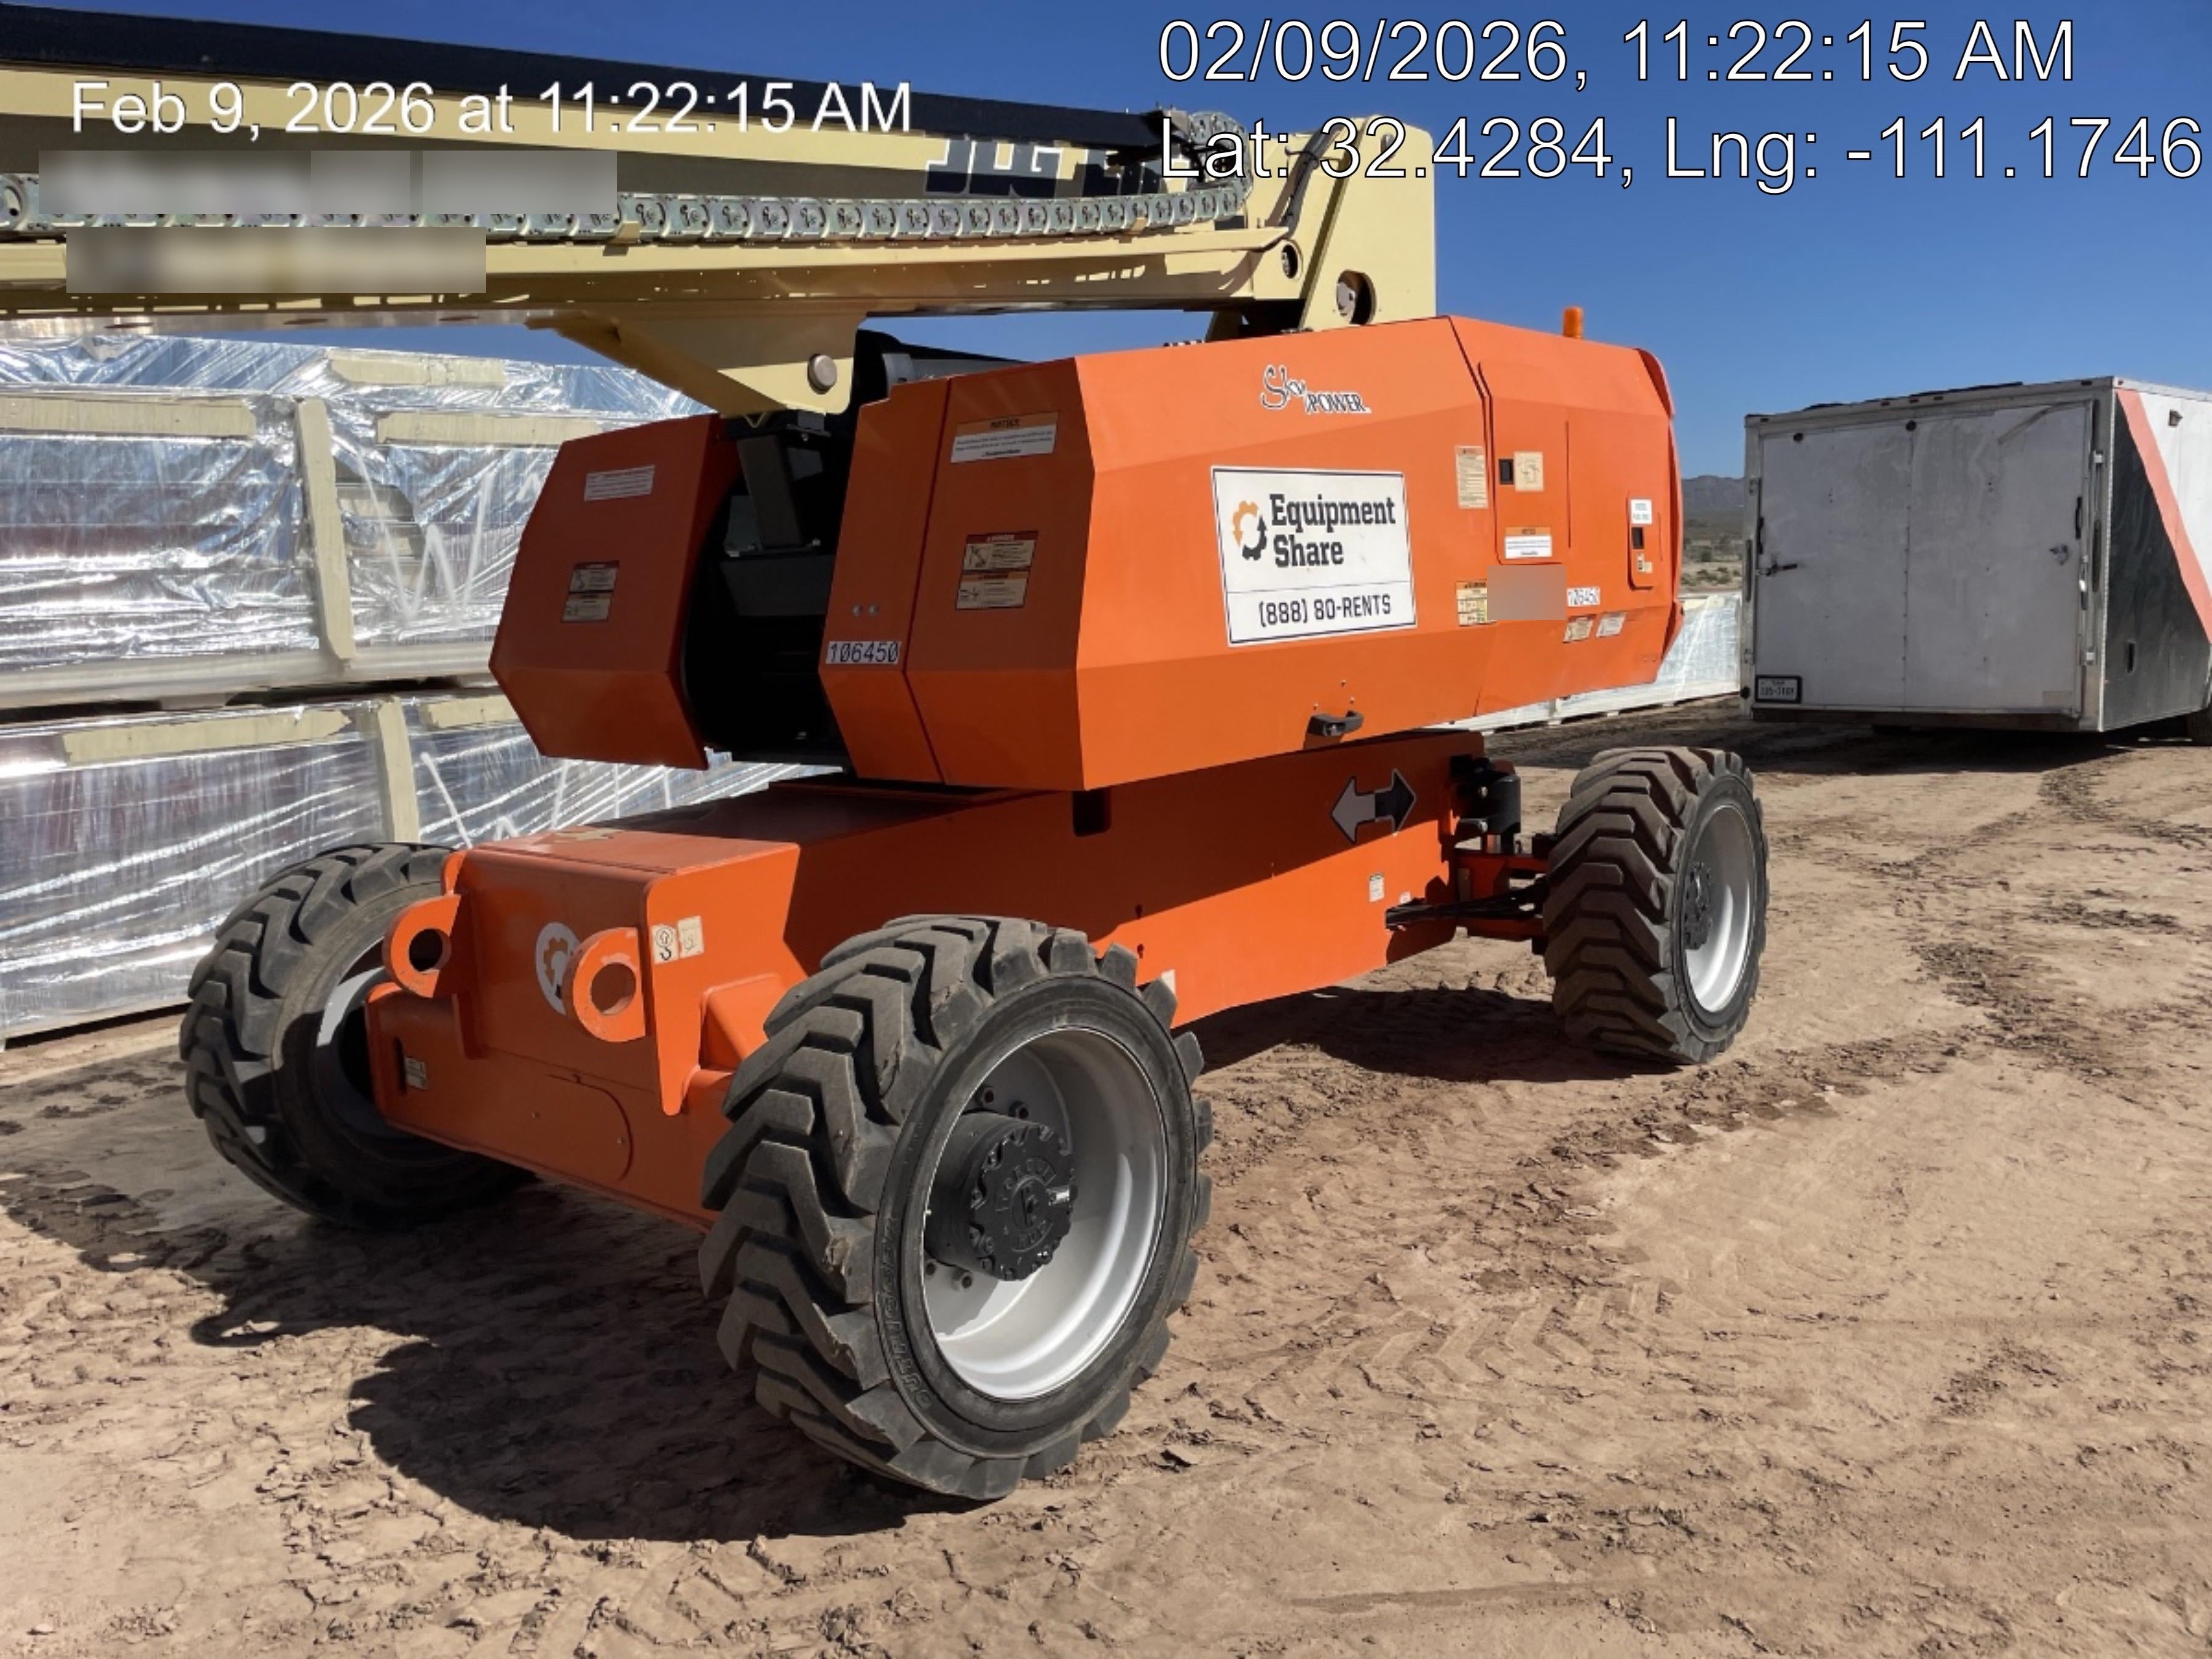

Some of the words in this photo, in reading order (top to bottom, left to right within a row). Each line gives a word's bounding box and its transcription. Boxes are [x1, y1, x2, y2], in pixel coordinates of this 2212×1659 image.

[1269, 493, 1396, 533] Equipment
[1273, 534, 1344, 568] Share
[1259, 598, 1308, 627] (888)
[1314, 594, 1391, 621] 80-RENTS
[830, 641, 899, 662] 106450
